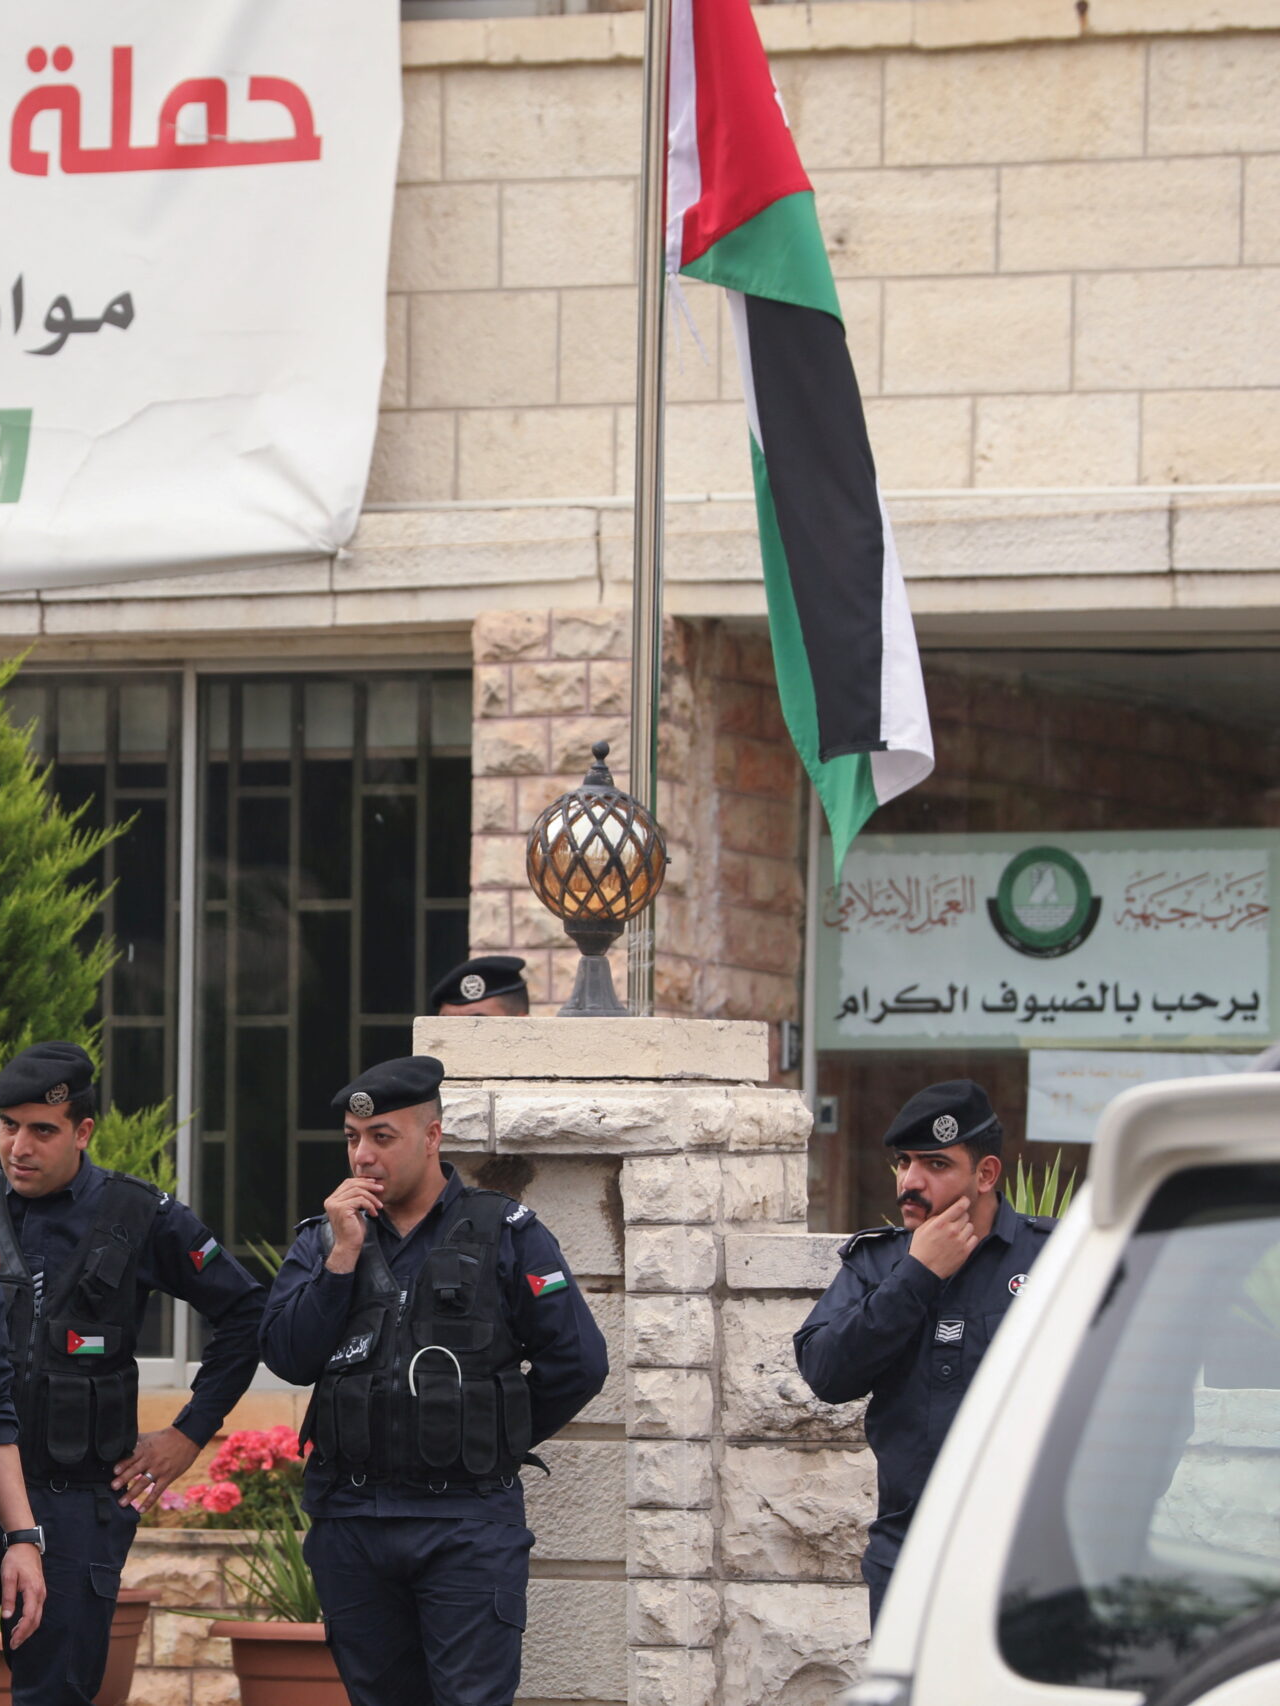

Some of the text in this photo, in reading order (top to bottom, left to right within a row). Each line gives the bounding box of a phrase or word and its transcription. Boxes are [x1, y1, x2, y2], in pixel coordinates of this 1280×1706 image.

[9, 45, 323, 177] حملة
[906, 873, 975, 934] العمل
[833, 980, 1260, 1025] يرحب بالضيوف الكرام
